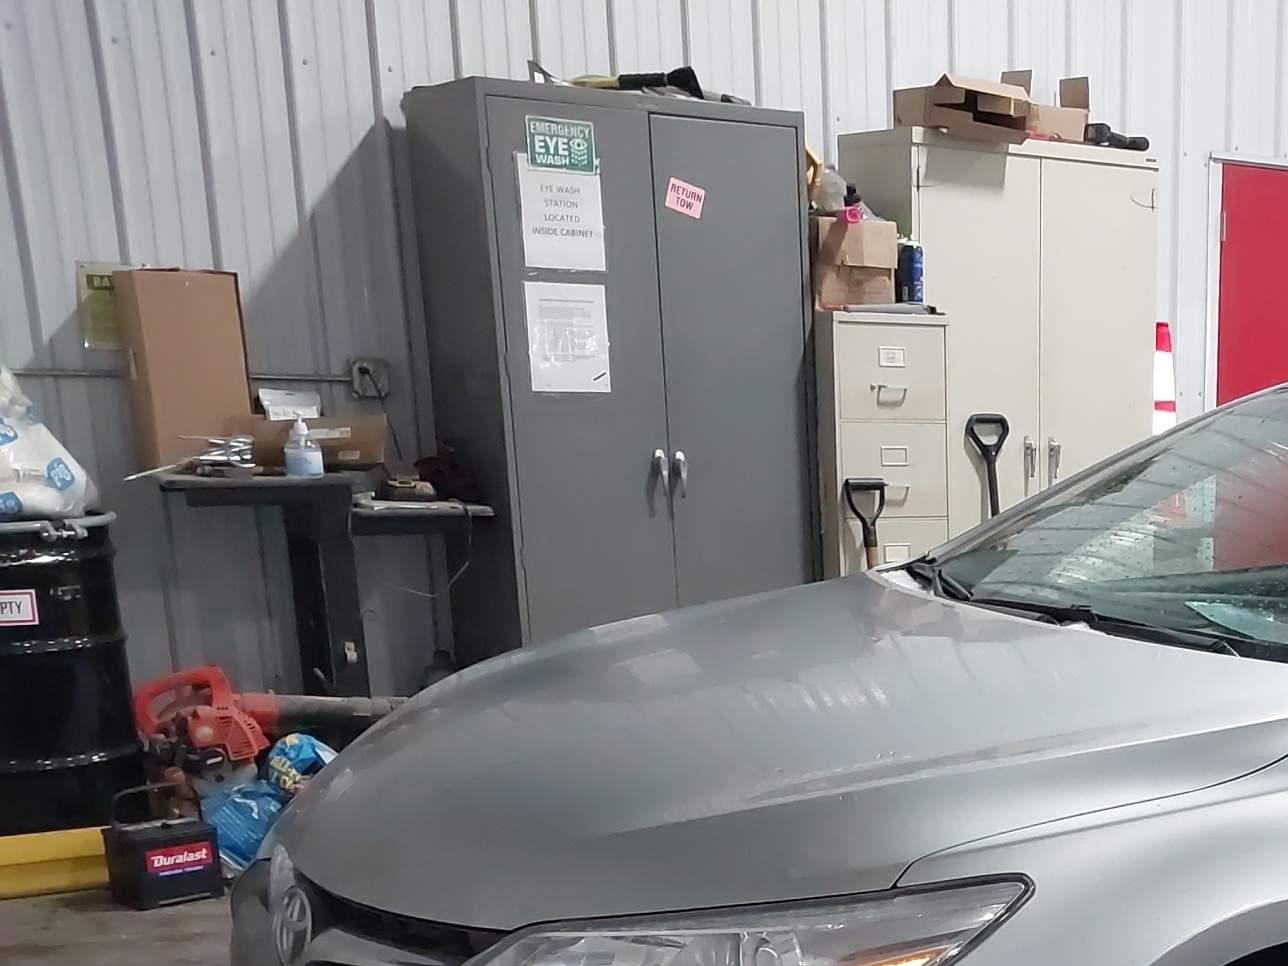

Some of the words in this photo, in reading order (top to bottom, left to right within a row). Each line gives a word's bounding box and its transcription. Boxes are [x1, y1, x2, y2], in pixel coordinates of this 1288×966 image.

[530, 120, 590, 138] EMERGENCY
[534, 135, 569, 155] EYE
[535, 153, 570, 166] WASH
[540, 184, 554, 192] EYE
[557, 185, 580, 194] WASH
[670, 183, 703, 204] RETURN
[544, 199, 579, 209] STATION
[676, 196, 694, 211] TOW
[544, 213, 580, 223] LOCATED
[532, 226, 557, 236] INSIDE
[560, 228, 593, 238] CABINET
[150, 847, 207, 868] Duralast
